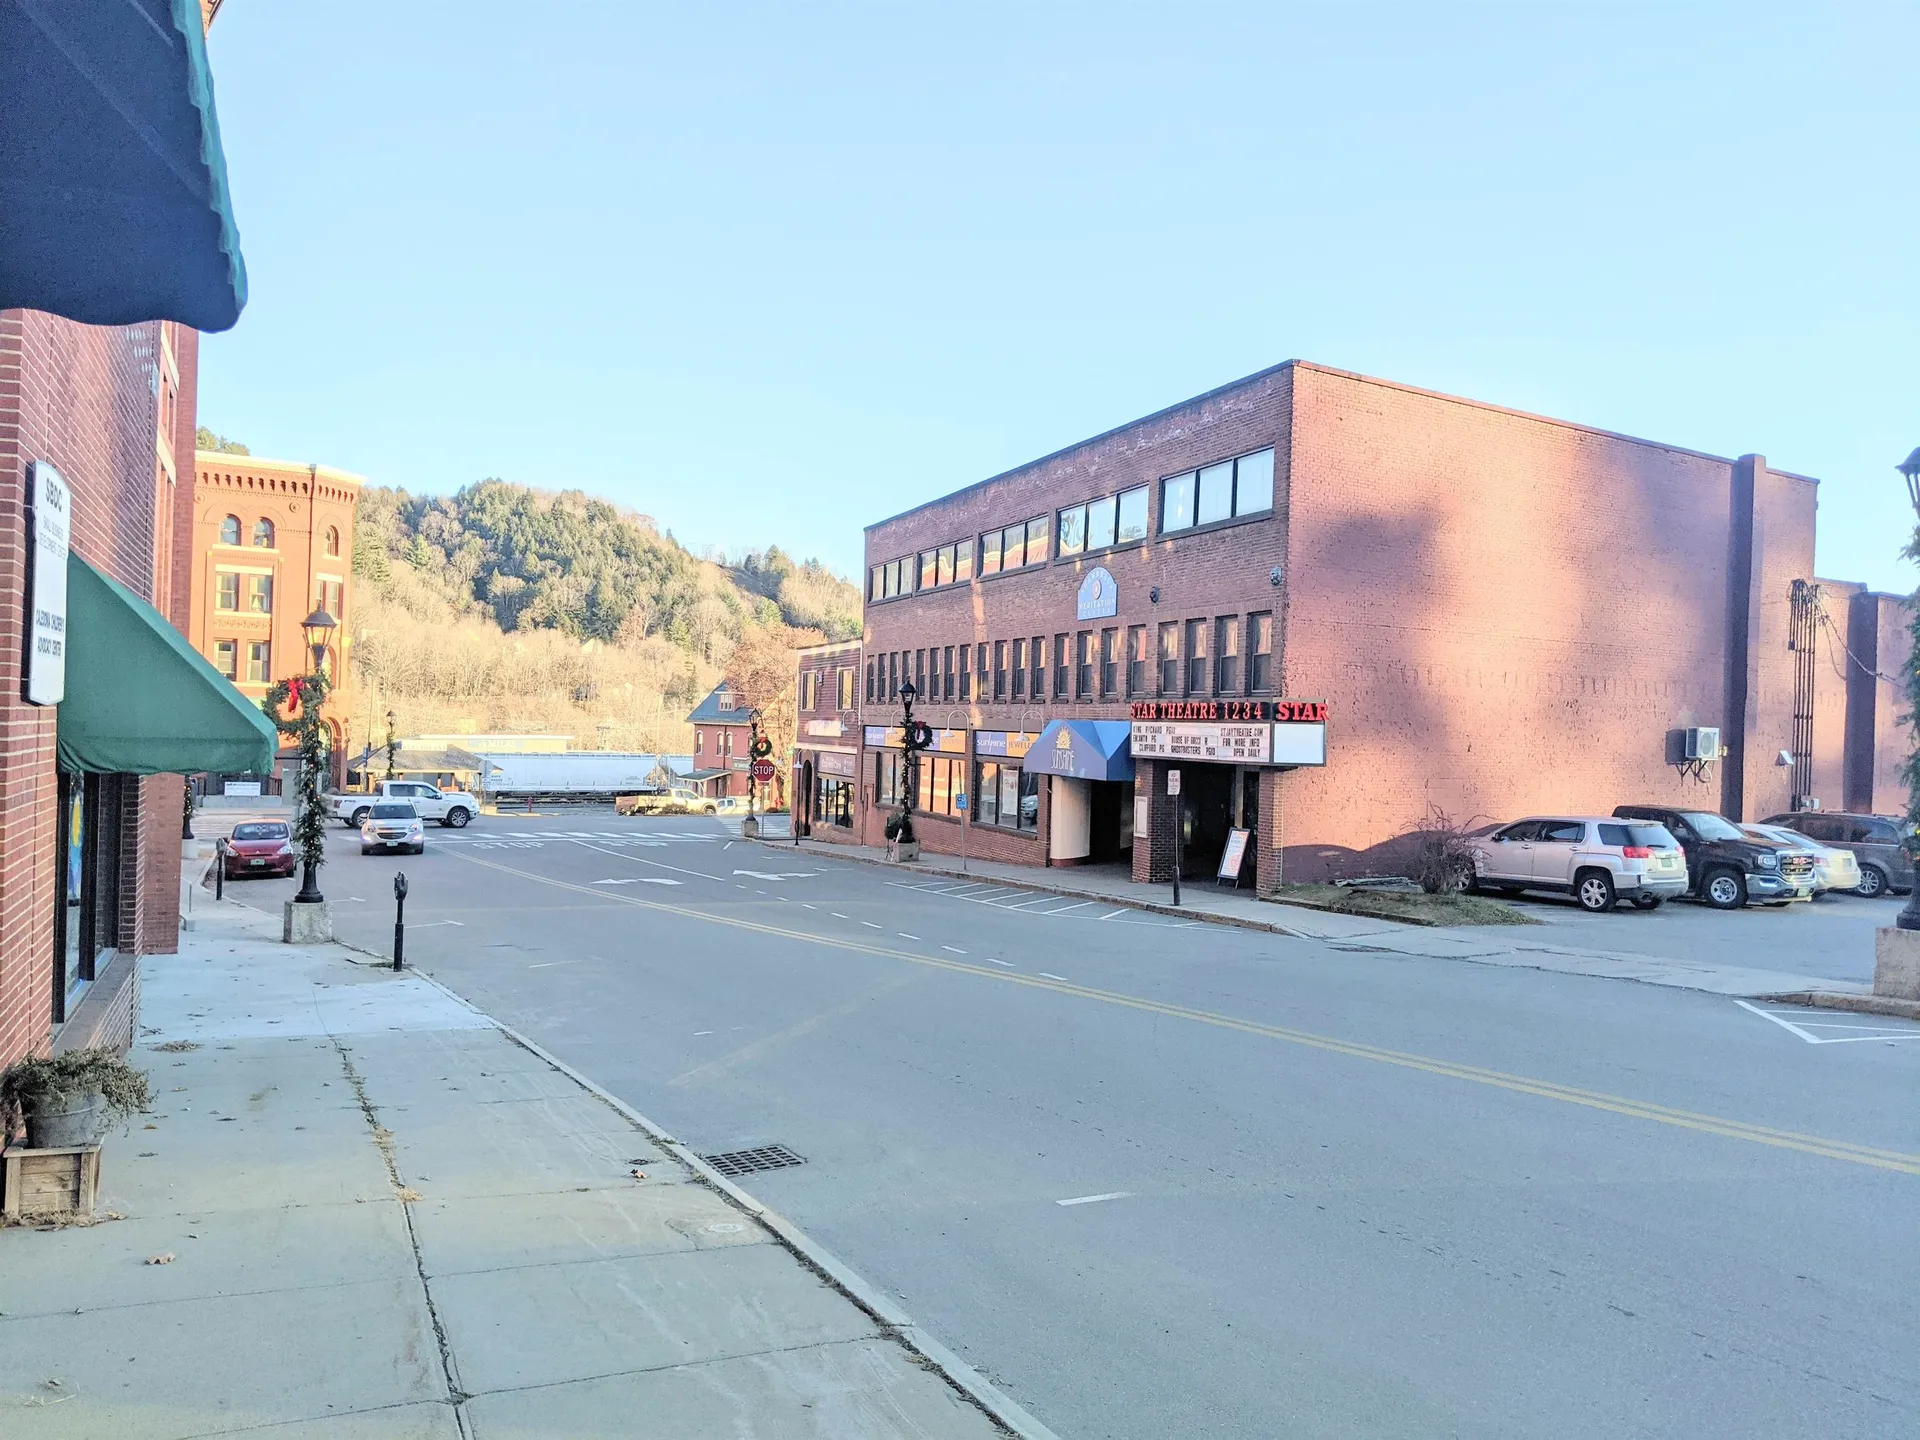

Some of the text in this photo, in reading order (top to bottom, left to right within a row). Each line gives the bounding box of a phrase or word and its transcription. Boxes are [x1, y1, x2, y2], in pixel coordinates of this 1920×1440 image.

[45, 477, 63, 513] SBDC
[1130, 702, 1156, 720] STAR
[1160, 702, 1217, 720] THEATRE
[1276, 701, 1330, 722] STAR
[1222, 737, 1260, 748] FOR MORE INFO
[1051, 749, 1075, 771] SUNSHINE
[1233, 748, 1261, 757] OPEN DAILY
[753, 765, 774, 775] STOP
